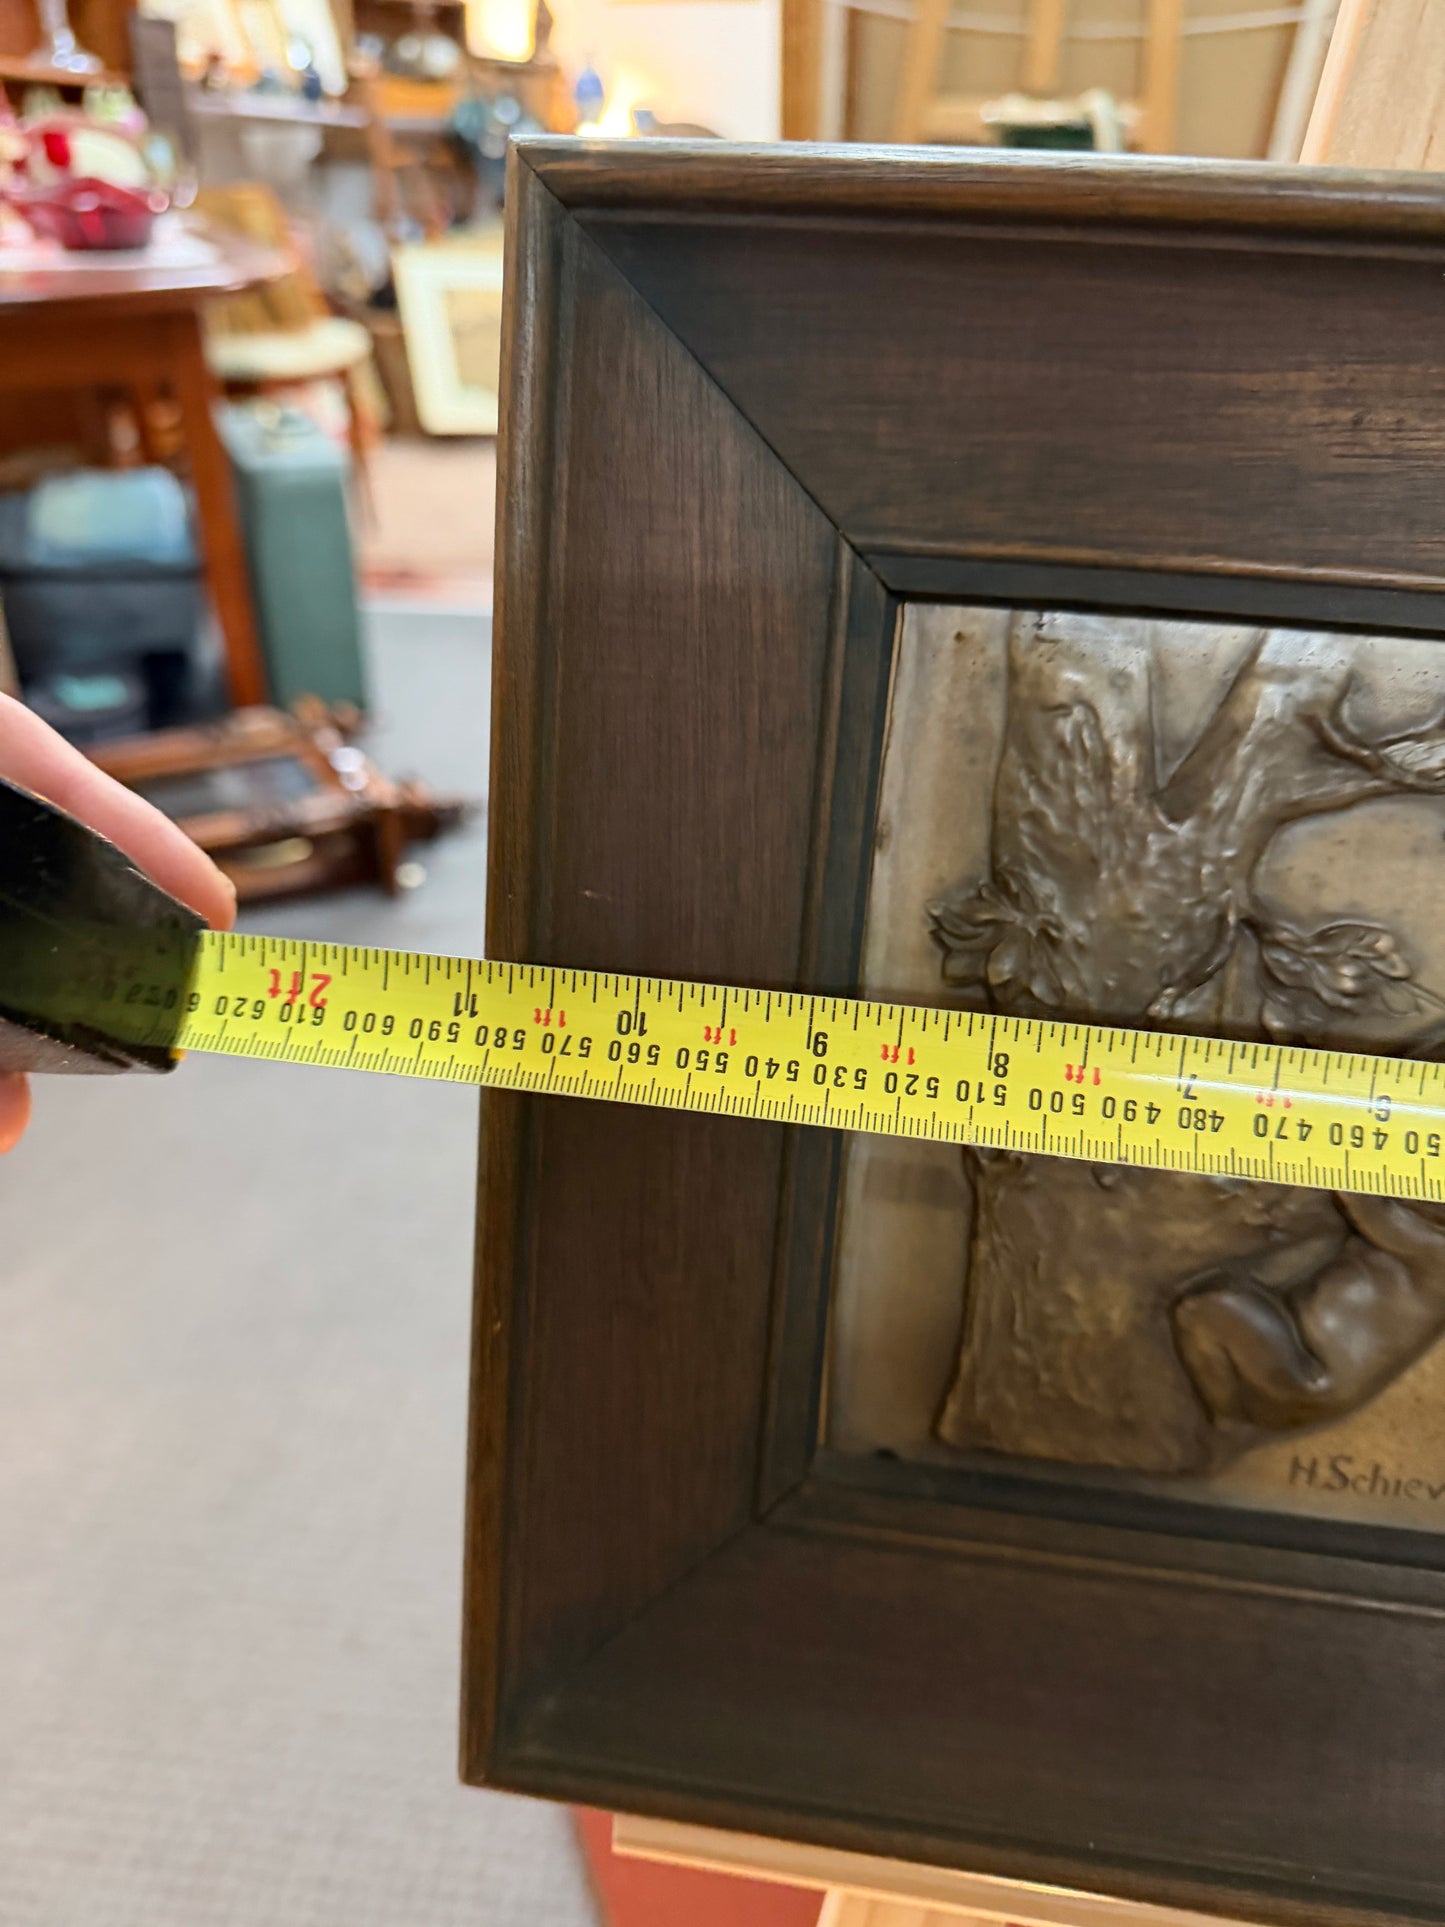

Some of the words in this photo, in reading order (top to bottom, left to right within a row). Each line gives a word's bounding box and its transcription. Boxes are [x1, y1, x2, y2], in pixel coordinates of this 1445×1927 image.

[268, 968, 332, 1008] 2ft
[215, 996, 265, 1019] 620
[279, 1003, 325, 1026] 610
[454, 992, 478, 1018] 11
[343, 1010, 395, 1035] 600
[409, 1018, 460, 1043] 590
[617, 1010, 648, 1037] 10
[475, 1025, 526, 1050] 580
[541, 1033, 592, 1058] 570
[812, 1031, 828, 1057] 9
[608, 1040, 661, 1066] 560
[675, 1048, 728, 1074] 550
[993, 1052, 1010, 1078] 8
[744, 1055, 800, 1082] 540
[813, 1063, 868, 1090] 530
[884, 1072, 940, 1099] 520
[955, 1079, 1007, 1106] 510
[1183, 1073, 1198, 1100] 7
[1028, 1088, 1085, 1116] 500
[1102, 1096, 1161, 1124] 490
[1178, 1107, 1225, 1133] 480
[1253, 1113, 1313, 1142] 470
[1329, 1122, 1389, 1150] 460
[1404, 1131, 1442, 1157] 50
[1322, 1454, 1445, 1501] Schiev
